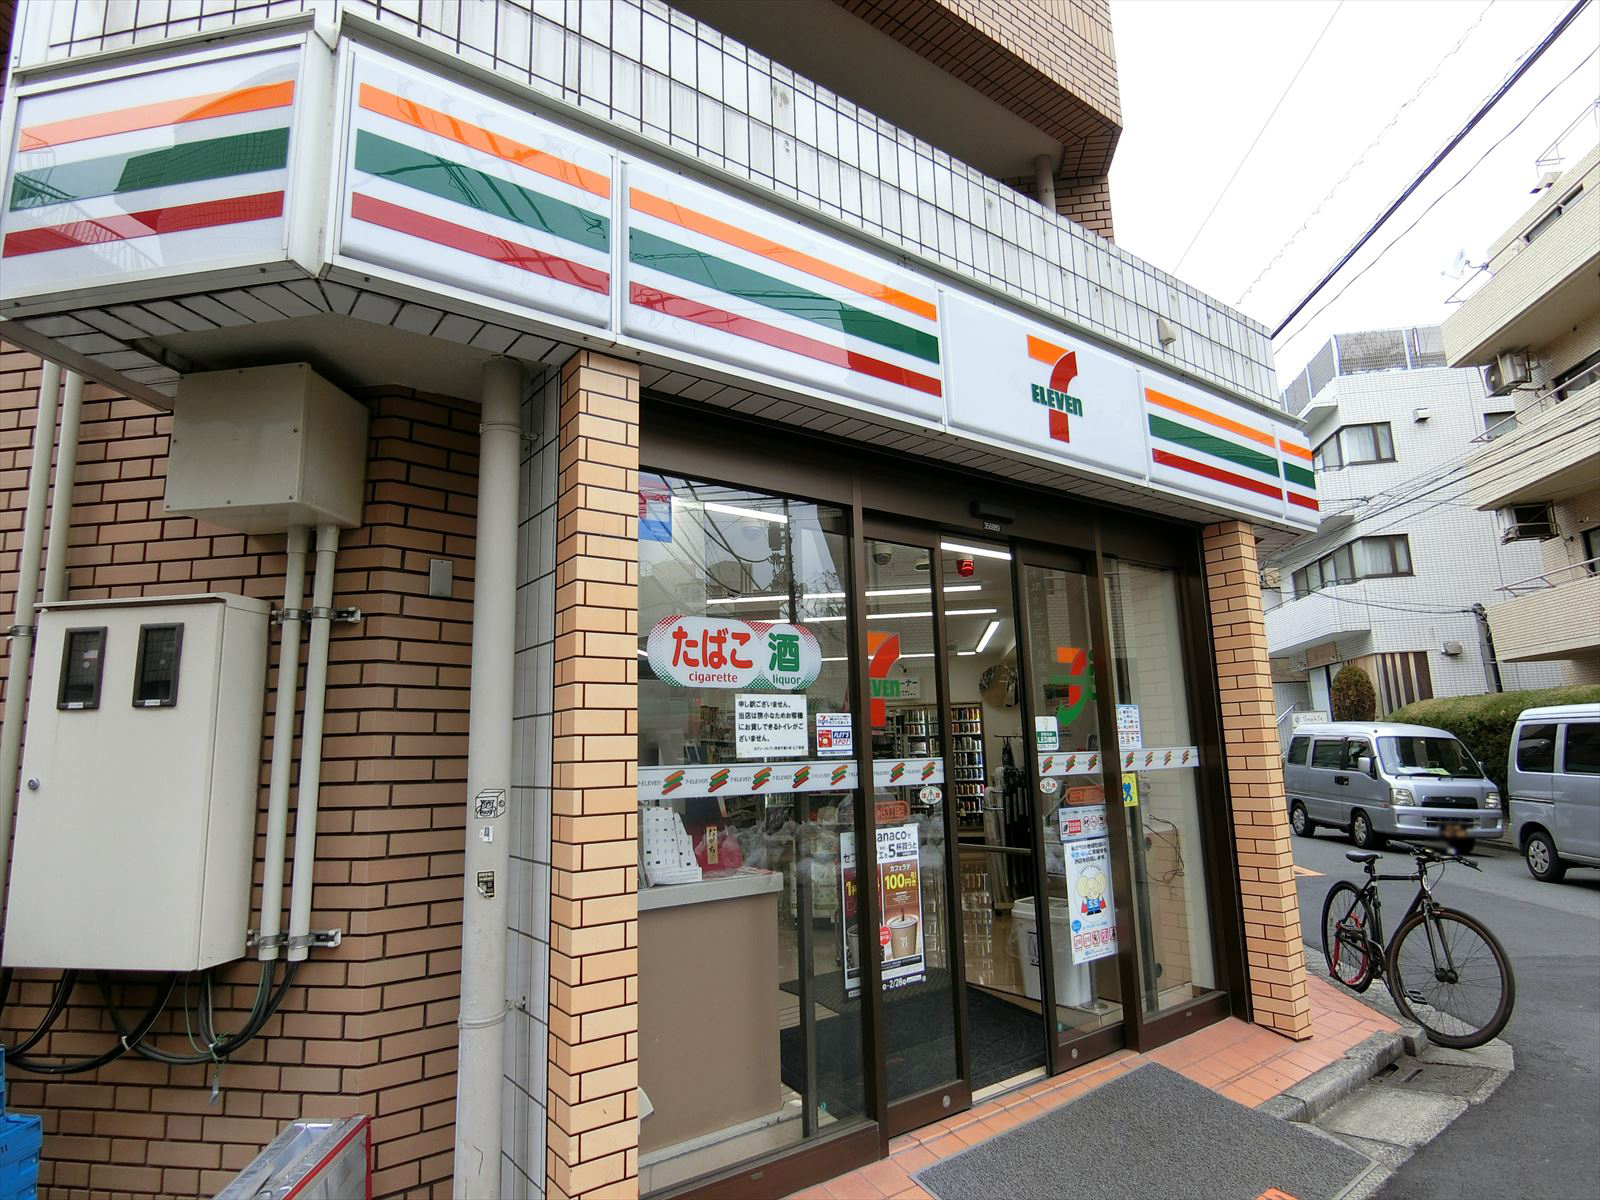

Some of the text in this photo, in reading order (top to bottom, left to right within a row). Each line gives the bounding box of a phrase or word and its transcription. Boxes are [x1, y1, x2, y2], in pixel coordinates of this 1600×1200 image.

[1026, 334, 1078, 444] 7
[672, 625, 800, 672] たばこ 酒
[688, 672, 801, 686] cigarette liquor
[738, 722, 804, 731] にお貸しできるトイレがご
[738, 734, 770, 743] ざいません。
